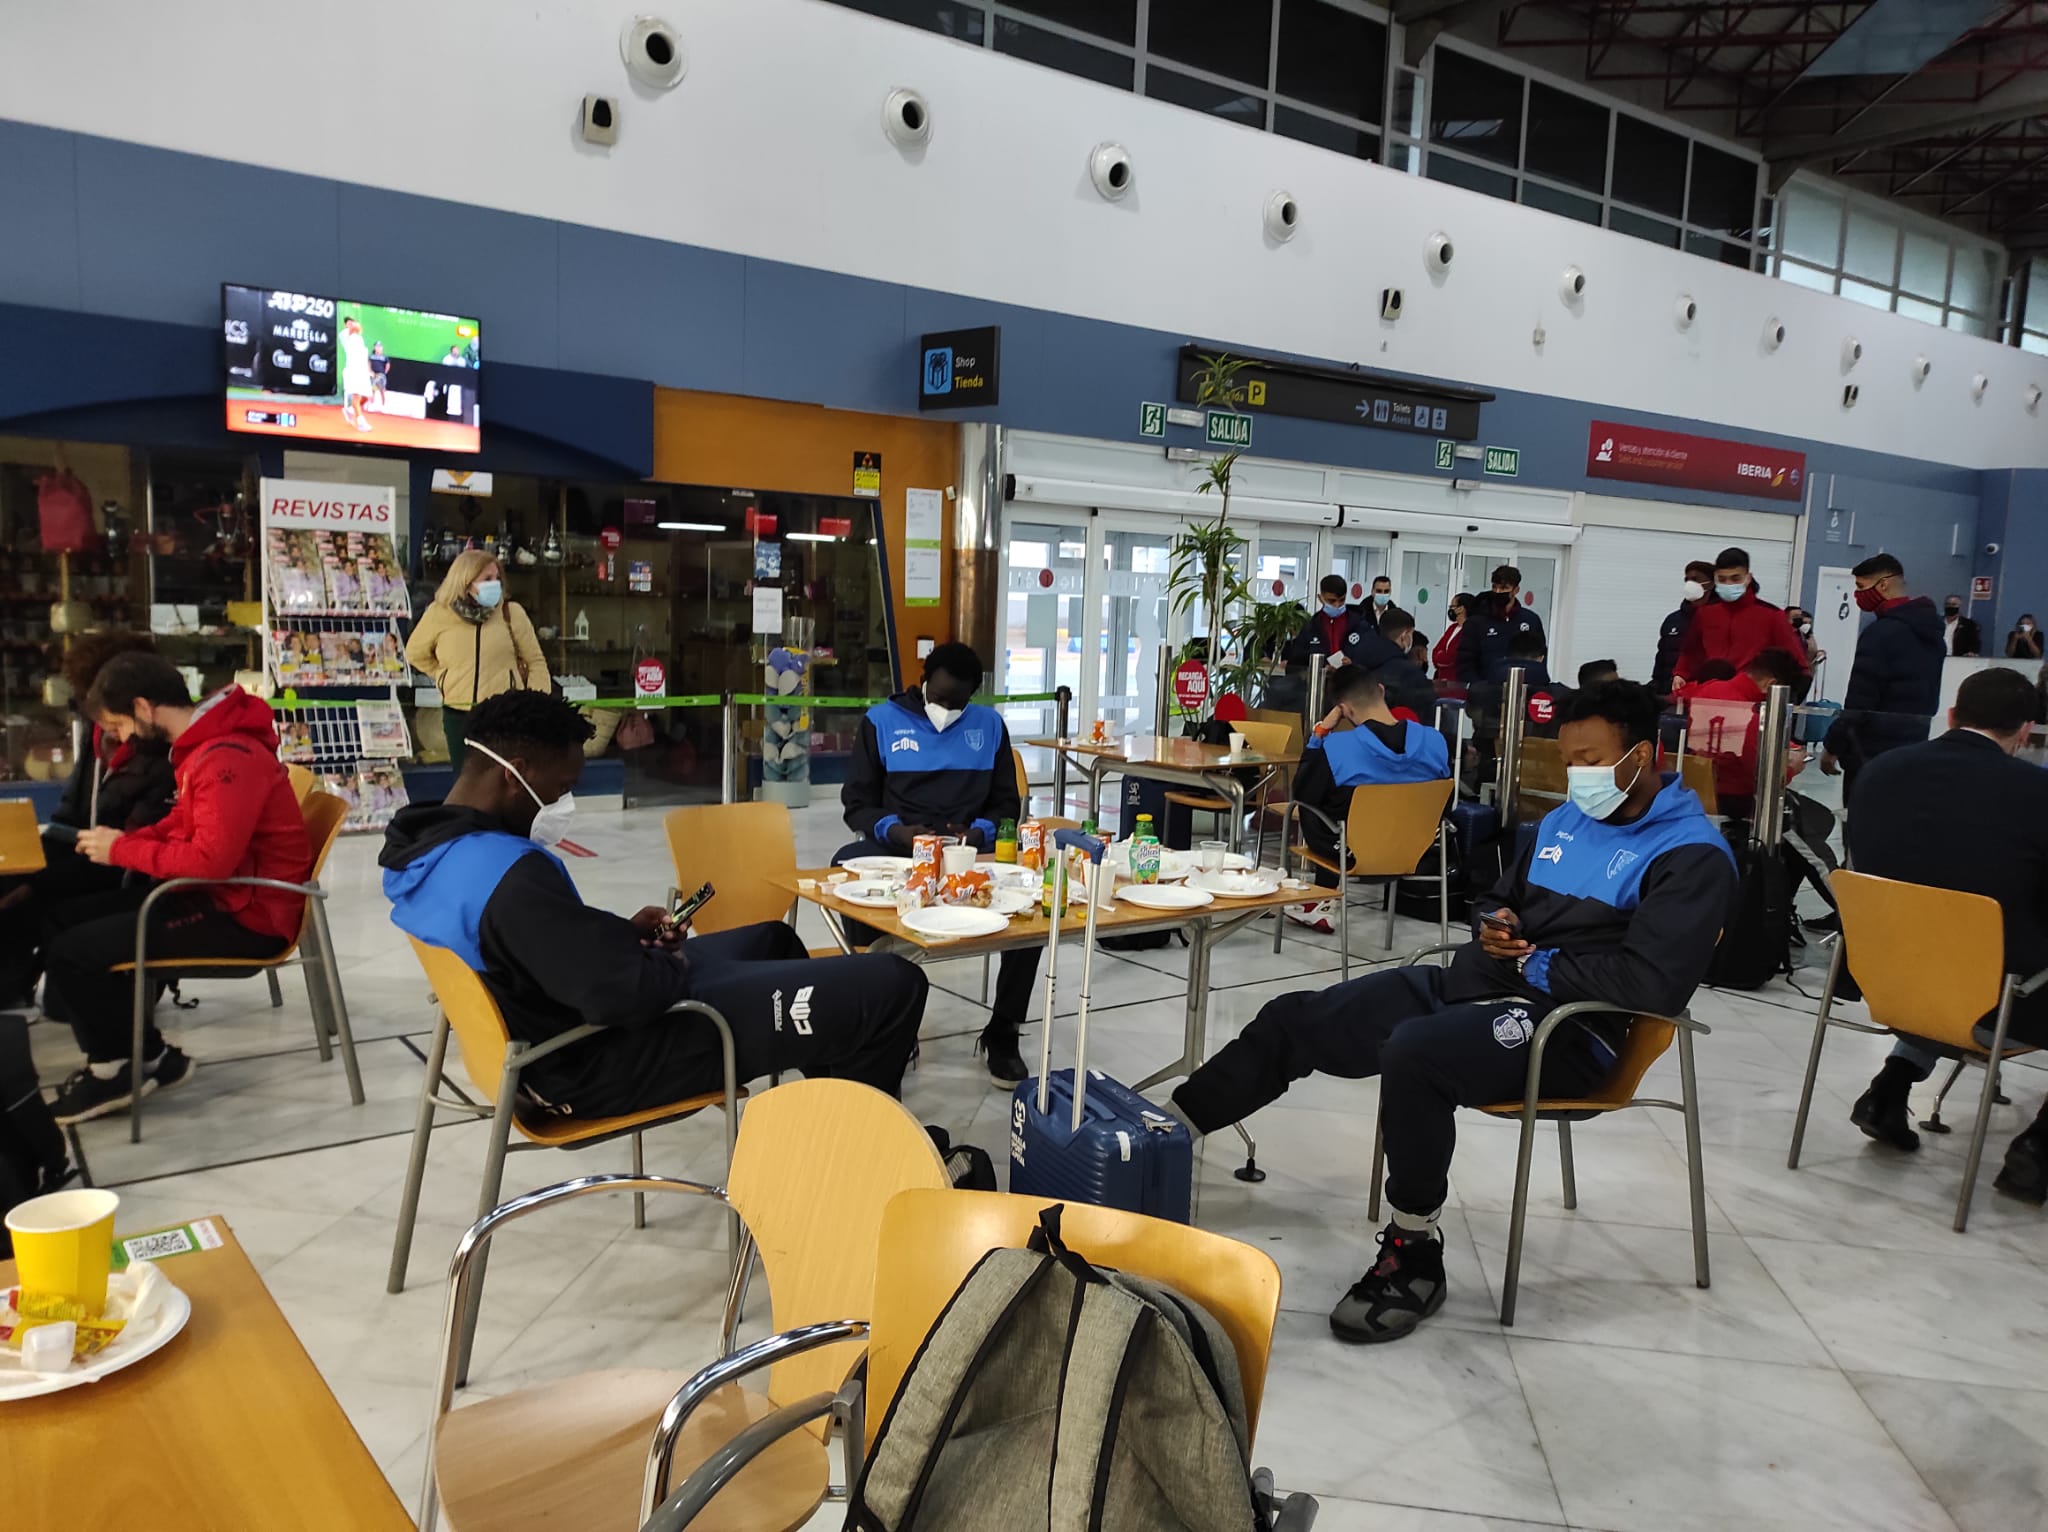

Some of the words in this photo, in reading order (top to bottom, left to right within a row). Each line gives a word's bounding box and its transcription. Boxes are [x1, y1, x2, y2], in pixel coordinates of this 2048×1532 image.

[273, 325, 328, 343] MARBELLA
[955, 356, 976, 368] Shop
[954, 374, 984, 389] Tienda
[1210, 416, 1249, 442] SALIDA
[1487, 450, 1515, 472] SALIDA
[1737, 463, 1772, 479] IBERIA
[272, 498, 390, 522] REVISTAS
